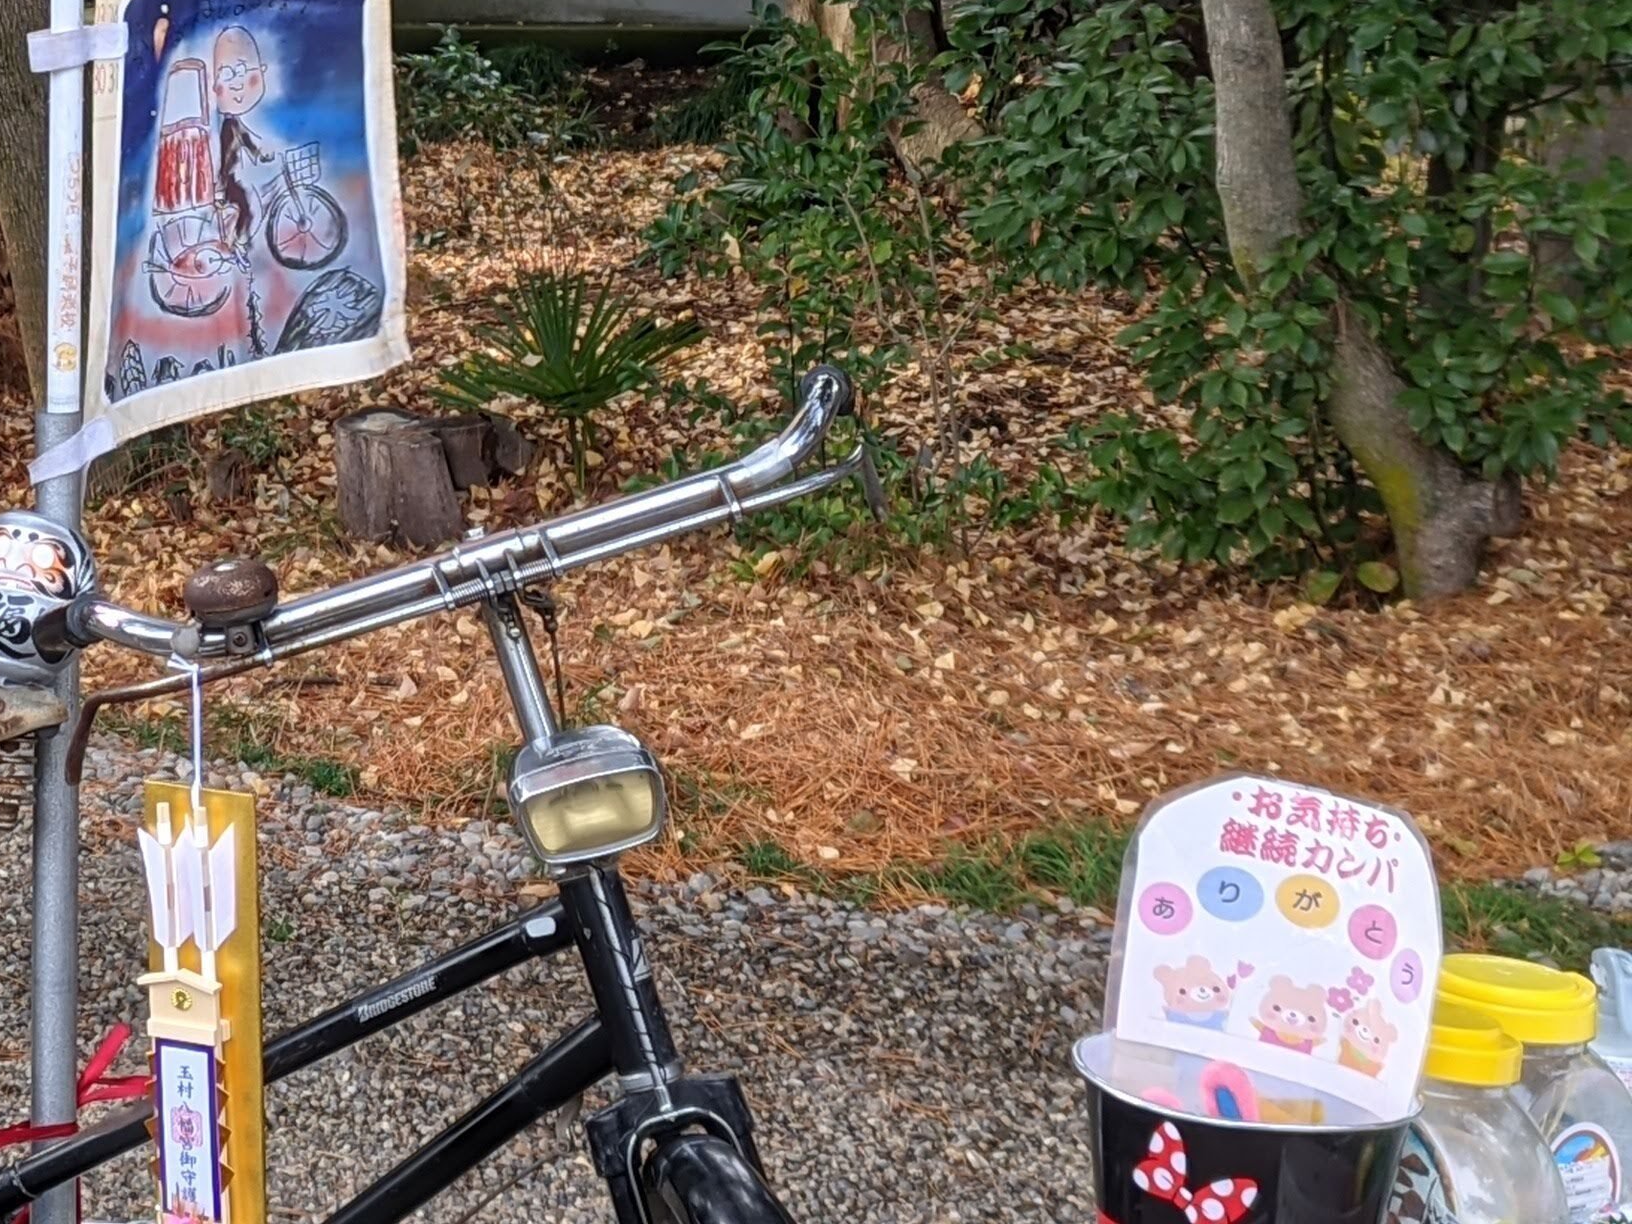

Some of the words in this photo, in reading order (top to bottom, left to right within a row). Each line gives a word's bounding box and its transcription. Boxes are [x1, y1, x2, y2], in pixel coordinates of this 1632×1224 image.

[1219, 818, 1398, 893] 継続カンパ
[1151, 879, 1416, 987] ありがとう
[358, 975, 436, 1023] BRIDGESTONE
